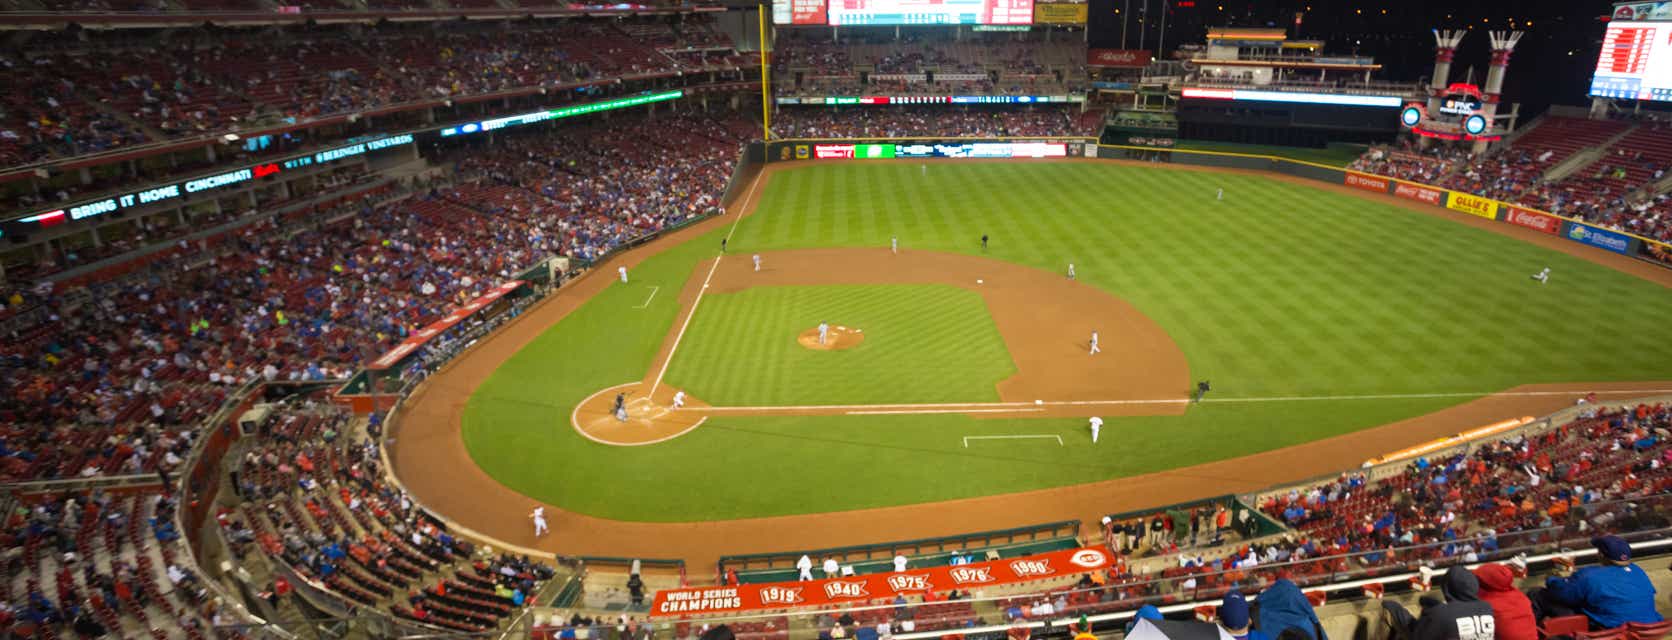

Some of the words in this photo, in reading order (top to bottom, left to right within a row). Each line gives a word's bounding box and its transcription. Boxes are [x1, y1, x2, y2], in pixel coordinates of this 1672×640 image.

[70, 199, 117, 220] BRING
[120, 194, 135, 208] IT
[138, 184, 180, 204] HOME
[185, 169, 252, 193] CINCINNATI
[367, 134, 415, 151] VINEYARDS
[1358, 177, 1386, 189] TOYOTA
[1455, 196, 1490, 213] OLLIE'S
[1515, 212, 1550, 229] Coca-Cola
[954, 567, 986, 582] 1976
[1013, 561, 1045, 575] 1990
[827, 583, 861, 597] 1940
[891, 576, 924, 590] 1975
[667, 590, 702, 602] WORLD
[703, 588, 737, 599] SERIES
[763, 590, 794, 603] 1919
[660, 597, 741, 613] CHAMPIONS
[1456, 615, 1495, 635] BIG
